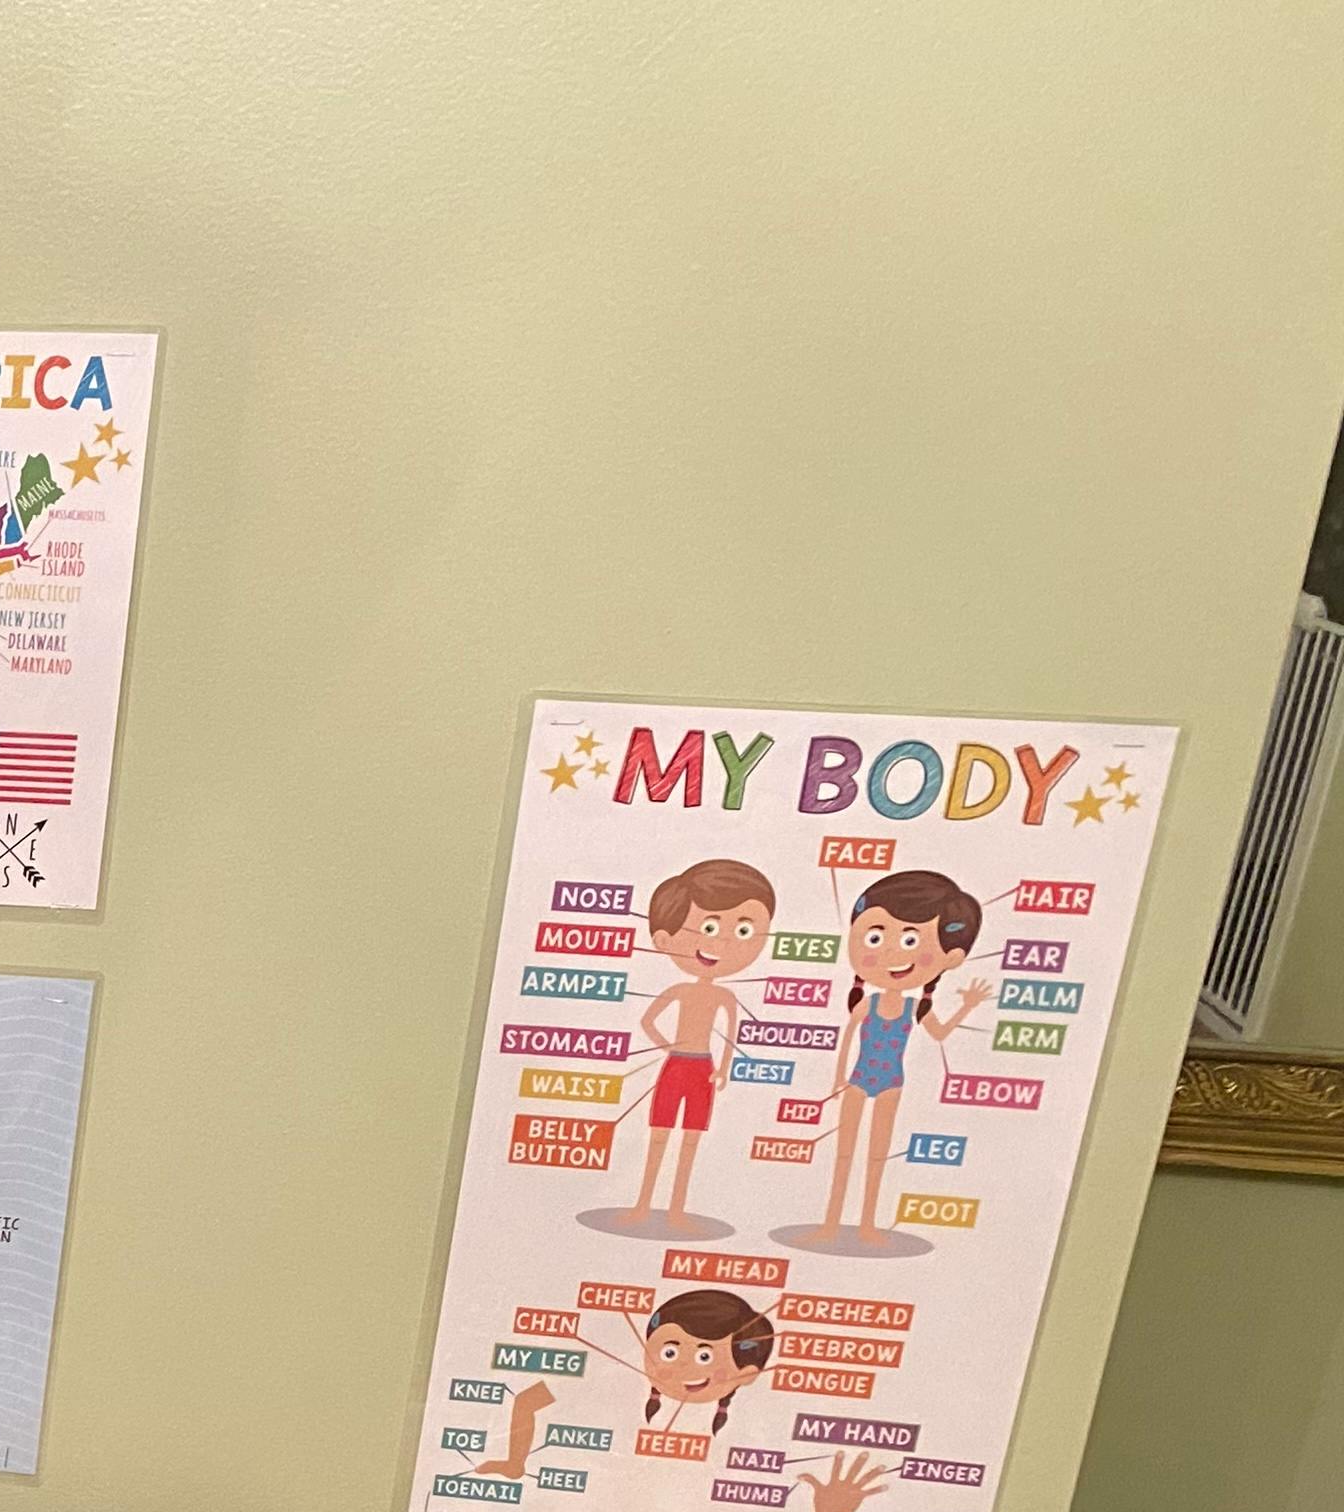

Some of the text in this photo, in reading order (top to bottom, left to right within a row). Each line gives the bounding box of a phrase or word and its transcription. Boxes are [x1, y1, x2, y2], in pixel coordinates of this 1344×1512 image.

[18, 477, 55, 511] MAINE
[46, 541, 84, 559] RHODE
[41, 561, 85, 577] ISLAND
[0, 611, 66, 629] NEW JERSEY
[8, 633, 66, 652] DELAWARE
[11, 656, 72, 674] MARYLAND
[611, 726, 1082, 827] MY BODY
[823, 841, 889, 865] FACE
[559, 887, 629, 911] NOSE
[1017, 887, 1092, 911] HAIR
[540, 926, 631, 953] MOUTH
[776, 937, 836, 960] EYES
[1006, 945, 1061, 968] EAR
[523, 971, 626, 997] ARMPIT
[766, 981, 829, 1003] NECK
[1002, 983, 1078, 1009] PALM
[503, 1029, 625, 1056] STOMACH
[740, 1025, 837, 1047] SHOULDER
[996, 1026, 1061, 1050] ARM
[733, 1062, 791, 1083] CHEST
[531, 1073, 611, 1098] WAIST
[945, 1079, 1040, 1105] ELBOW
[783, 1103, 820, 1120] HIP
[527, 1119, 597, 1143] BELLY
[511, 1142, 606, 1167] BUTTON
[754, 1141, 813, 1160] THIGH
[912, 1138, 962, 1161] LEG
[903, 1199, 975, 1222] FOOT
[670, 1254, 780, 1281] MY HEAD
[580, 1287, 652, 1310] CHEEK
[516, 1312, 578, 1334] CHIN
[782, 1298, 910, 1326] FOREHEAD
[496, 1348, 582, 1372] MY LEG
[783, 1336, 900, 1364] EYEBROW
[453, 1382, 503, 1401] KNEE
[774, 1369, 870, 1394] TONGUE
[446, 1431, 485, 1450] TOE
[547, 1428, 612, 1449] ANKLE
[798, 1419, 913, 1447] MY HAND
[639, 1433, 707, 1457] TEETH
[729, 1451, 783, 1471] NAIL
[901, 1461, 983, 1484] FINGER
[436, 1478, 519, 1502] TOENAIL
[539, 1470, 585, 1490] HEEL
[714, 1483, 783, 1505] THUMB
